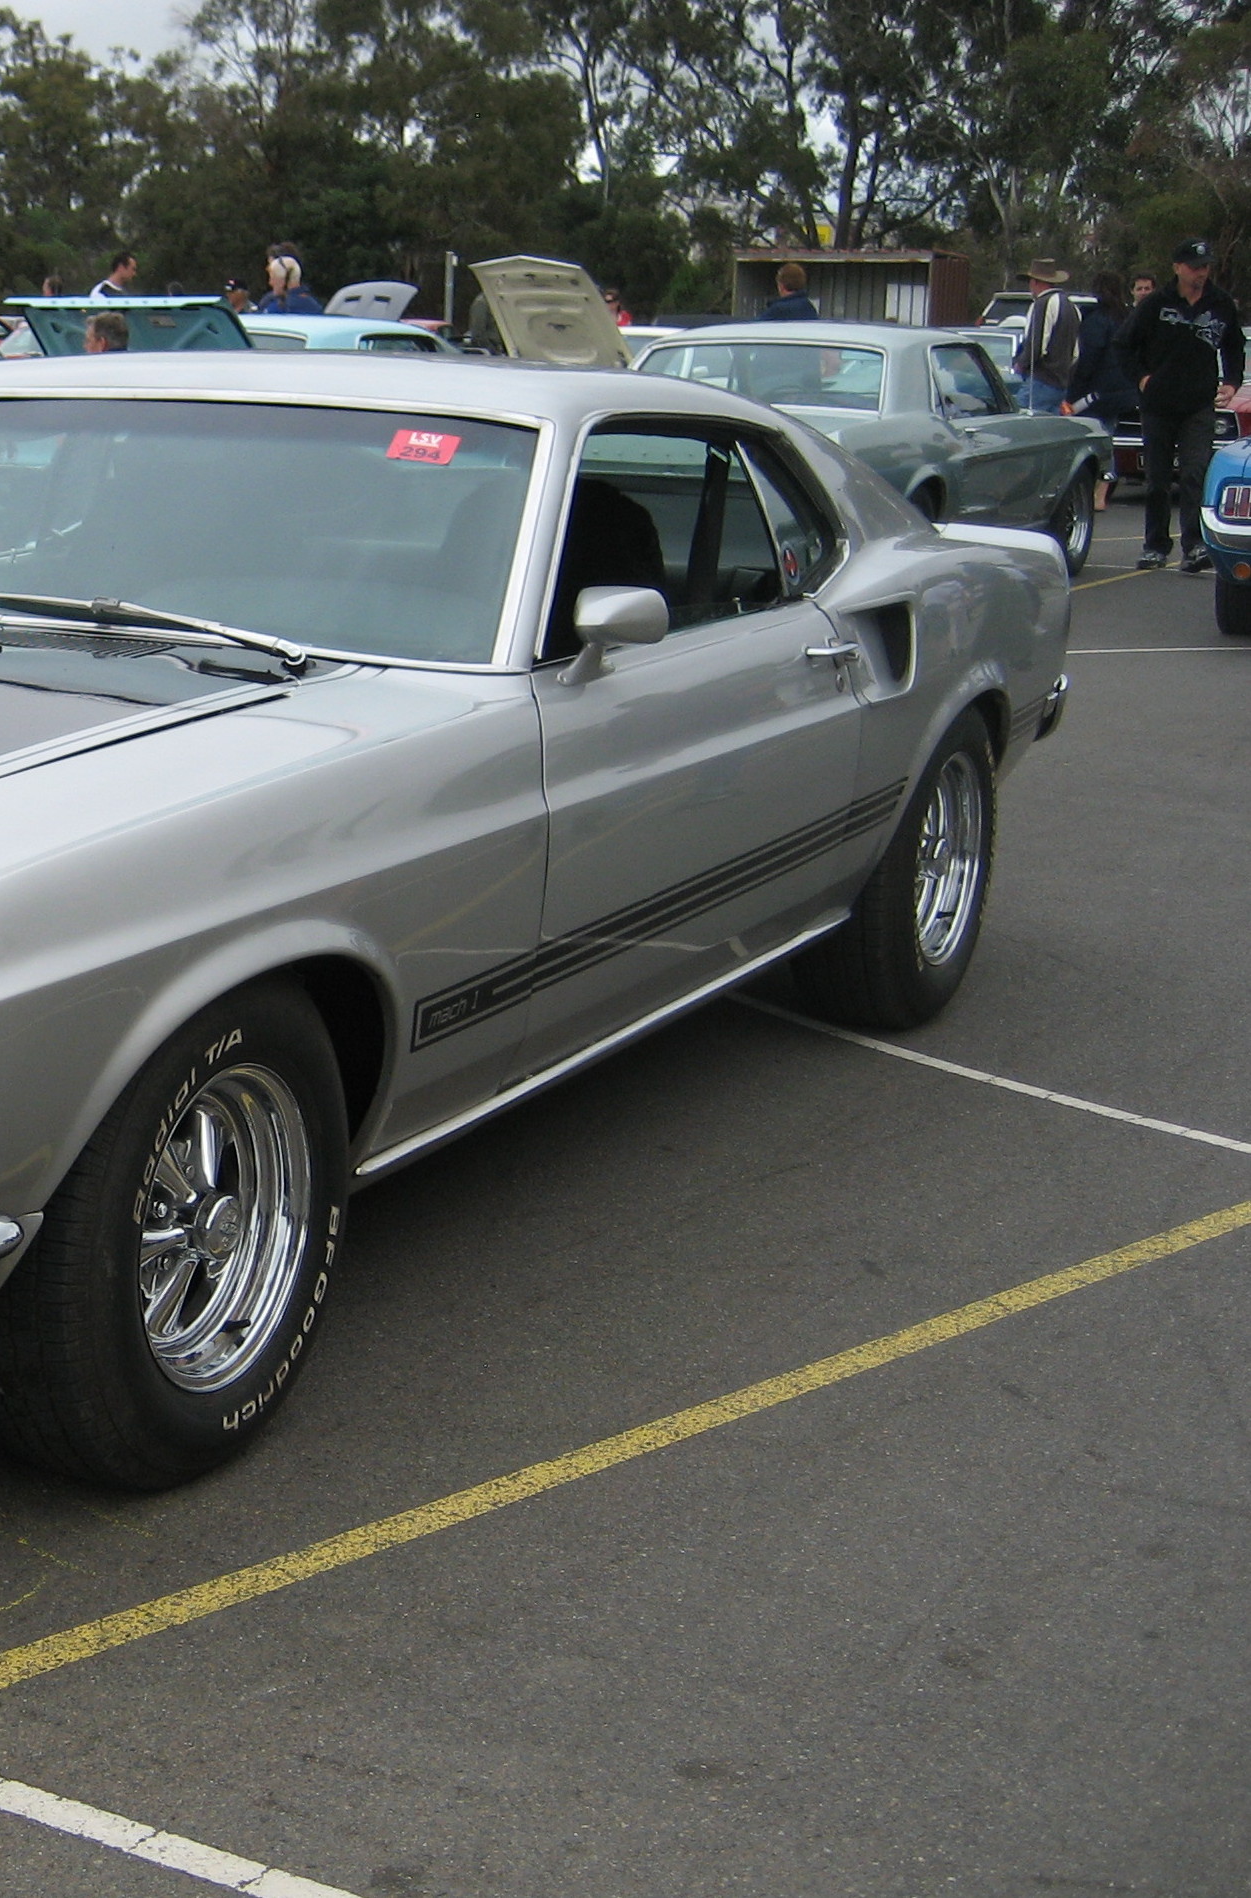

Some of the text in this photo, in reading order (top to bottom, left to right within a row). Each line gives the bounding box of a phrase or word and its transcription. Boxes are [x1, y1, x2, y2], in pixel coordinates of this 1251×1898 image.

[408, 431, 443, 448] LSV
[399, 446, 441, 461] 294
[133, 1028, 244, 1225] Radial T/A
